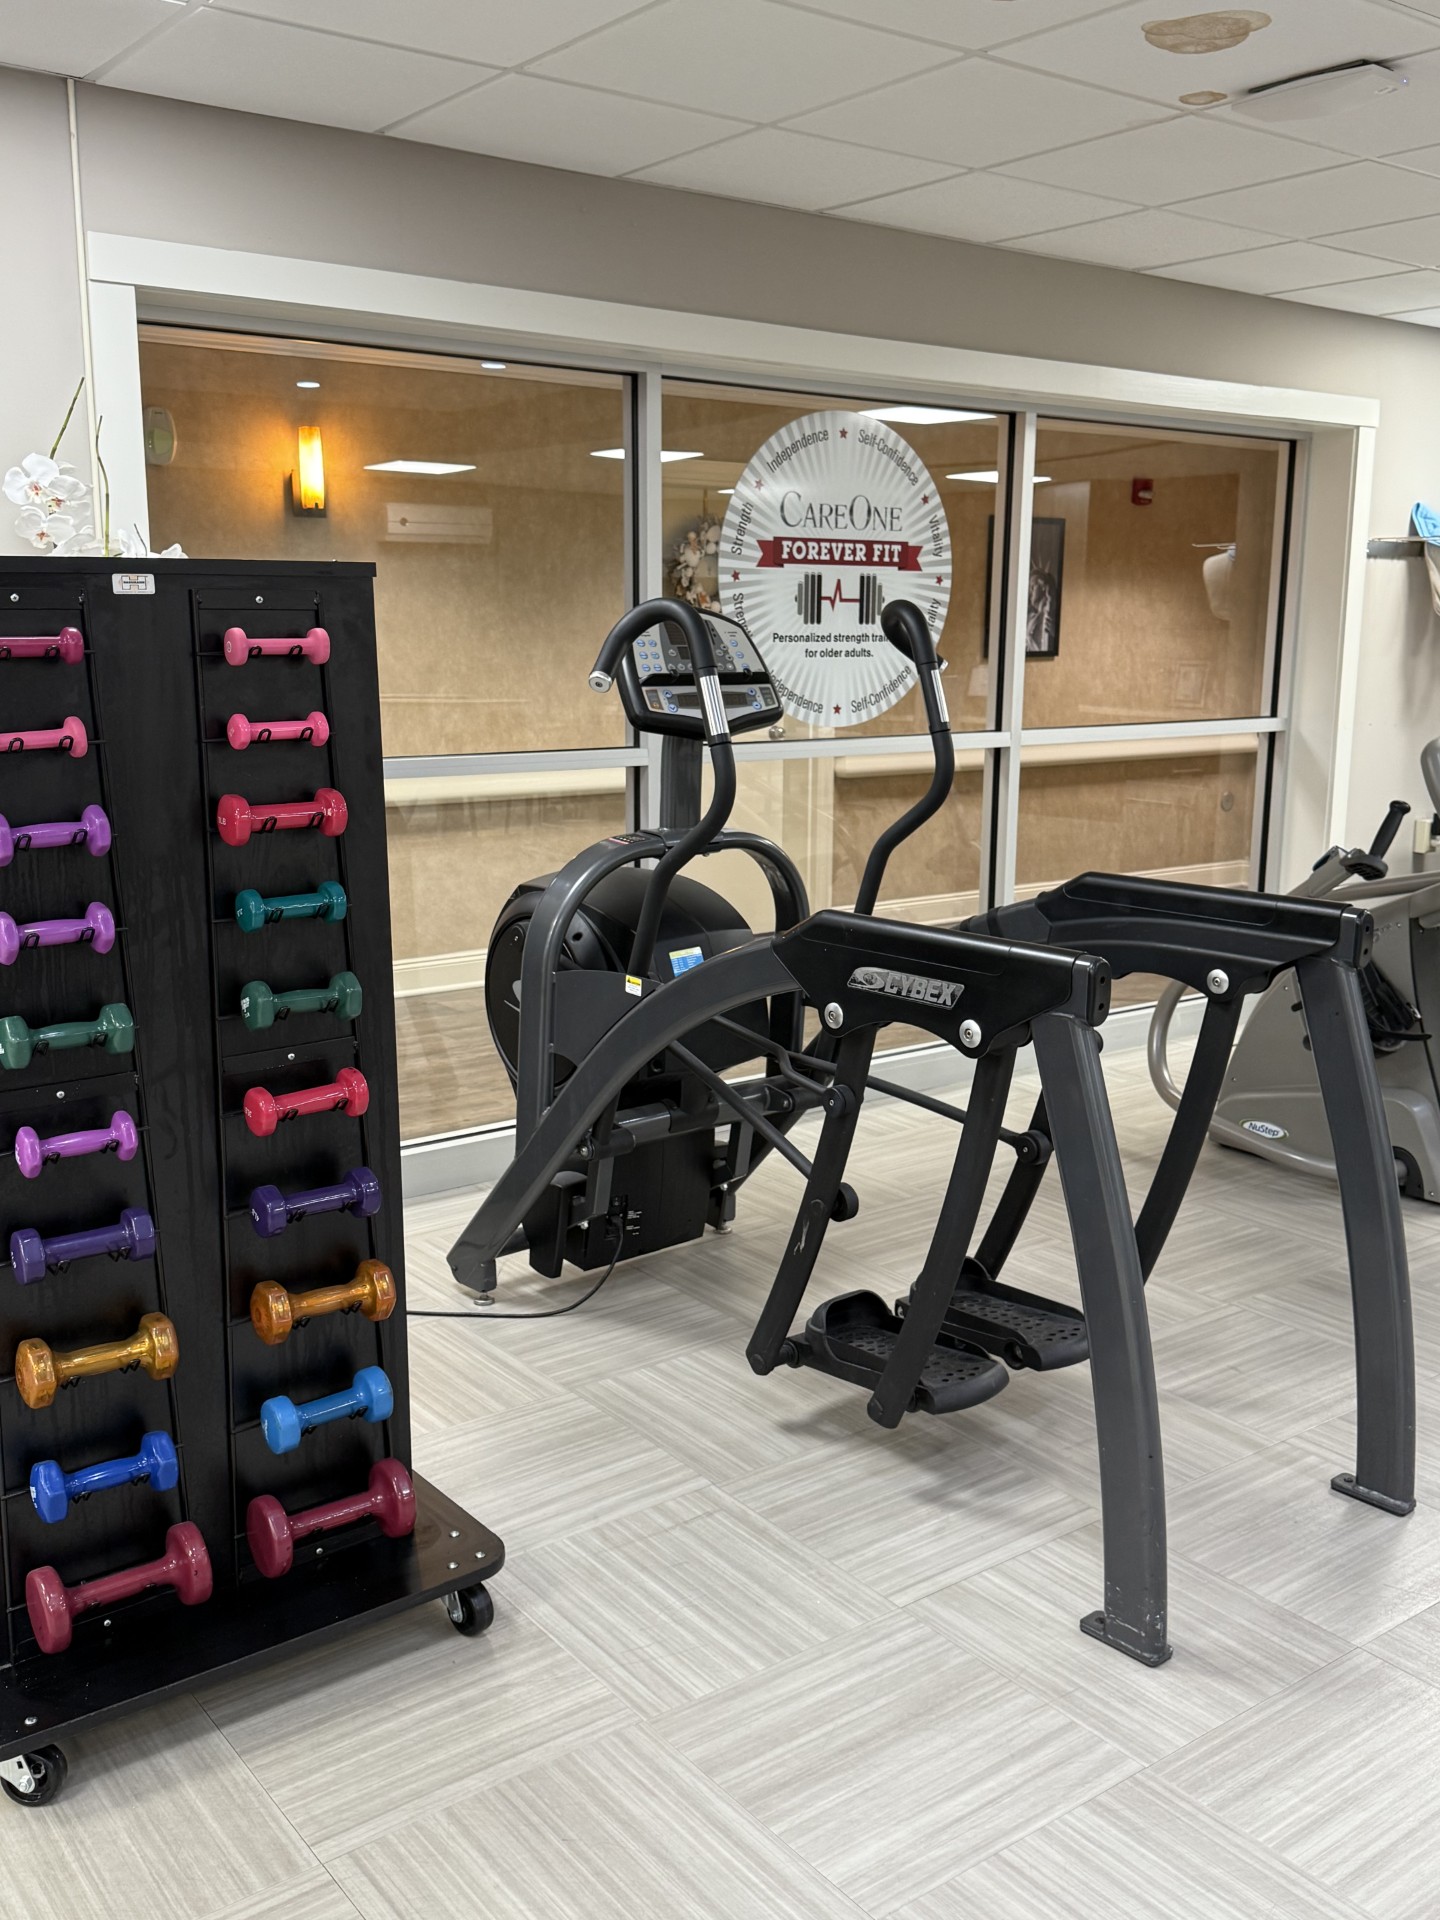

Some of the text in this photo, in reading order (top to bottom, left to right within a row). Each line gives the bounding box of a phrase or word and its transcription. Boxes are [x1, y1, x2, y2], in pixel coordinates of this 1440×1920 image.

[766, 430, 829, 473] Independence
[858, 429, 919, 486] Self-Confidence
[731, 501, 755, 556] Strength
[928, 514, 943, 558] Vitality
[781, 540, 902, 563] FOREVER FIT
[773, 632, 832, 643] Personalized
[833, 633, 870, 644] strength
[805, 648, 874, 658] for older adults.
[851, 665, 912, 713] Self-Confidence
[884, 971, 957, 1006] CYBEX
[1248, 1122, 1280, 1137] NuStep
